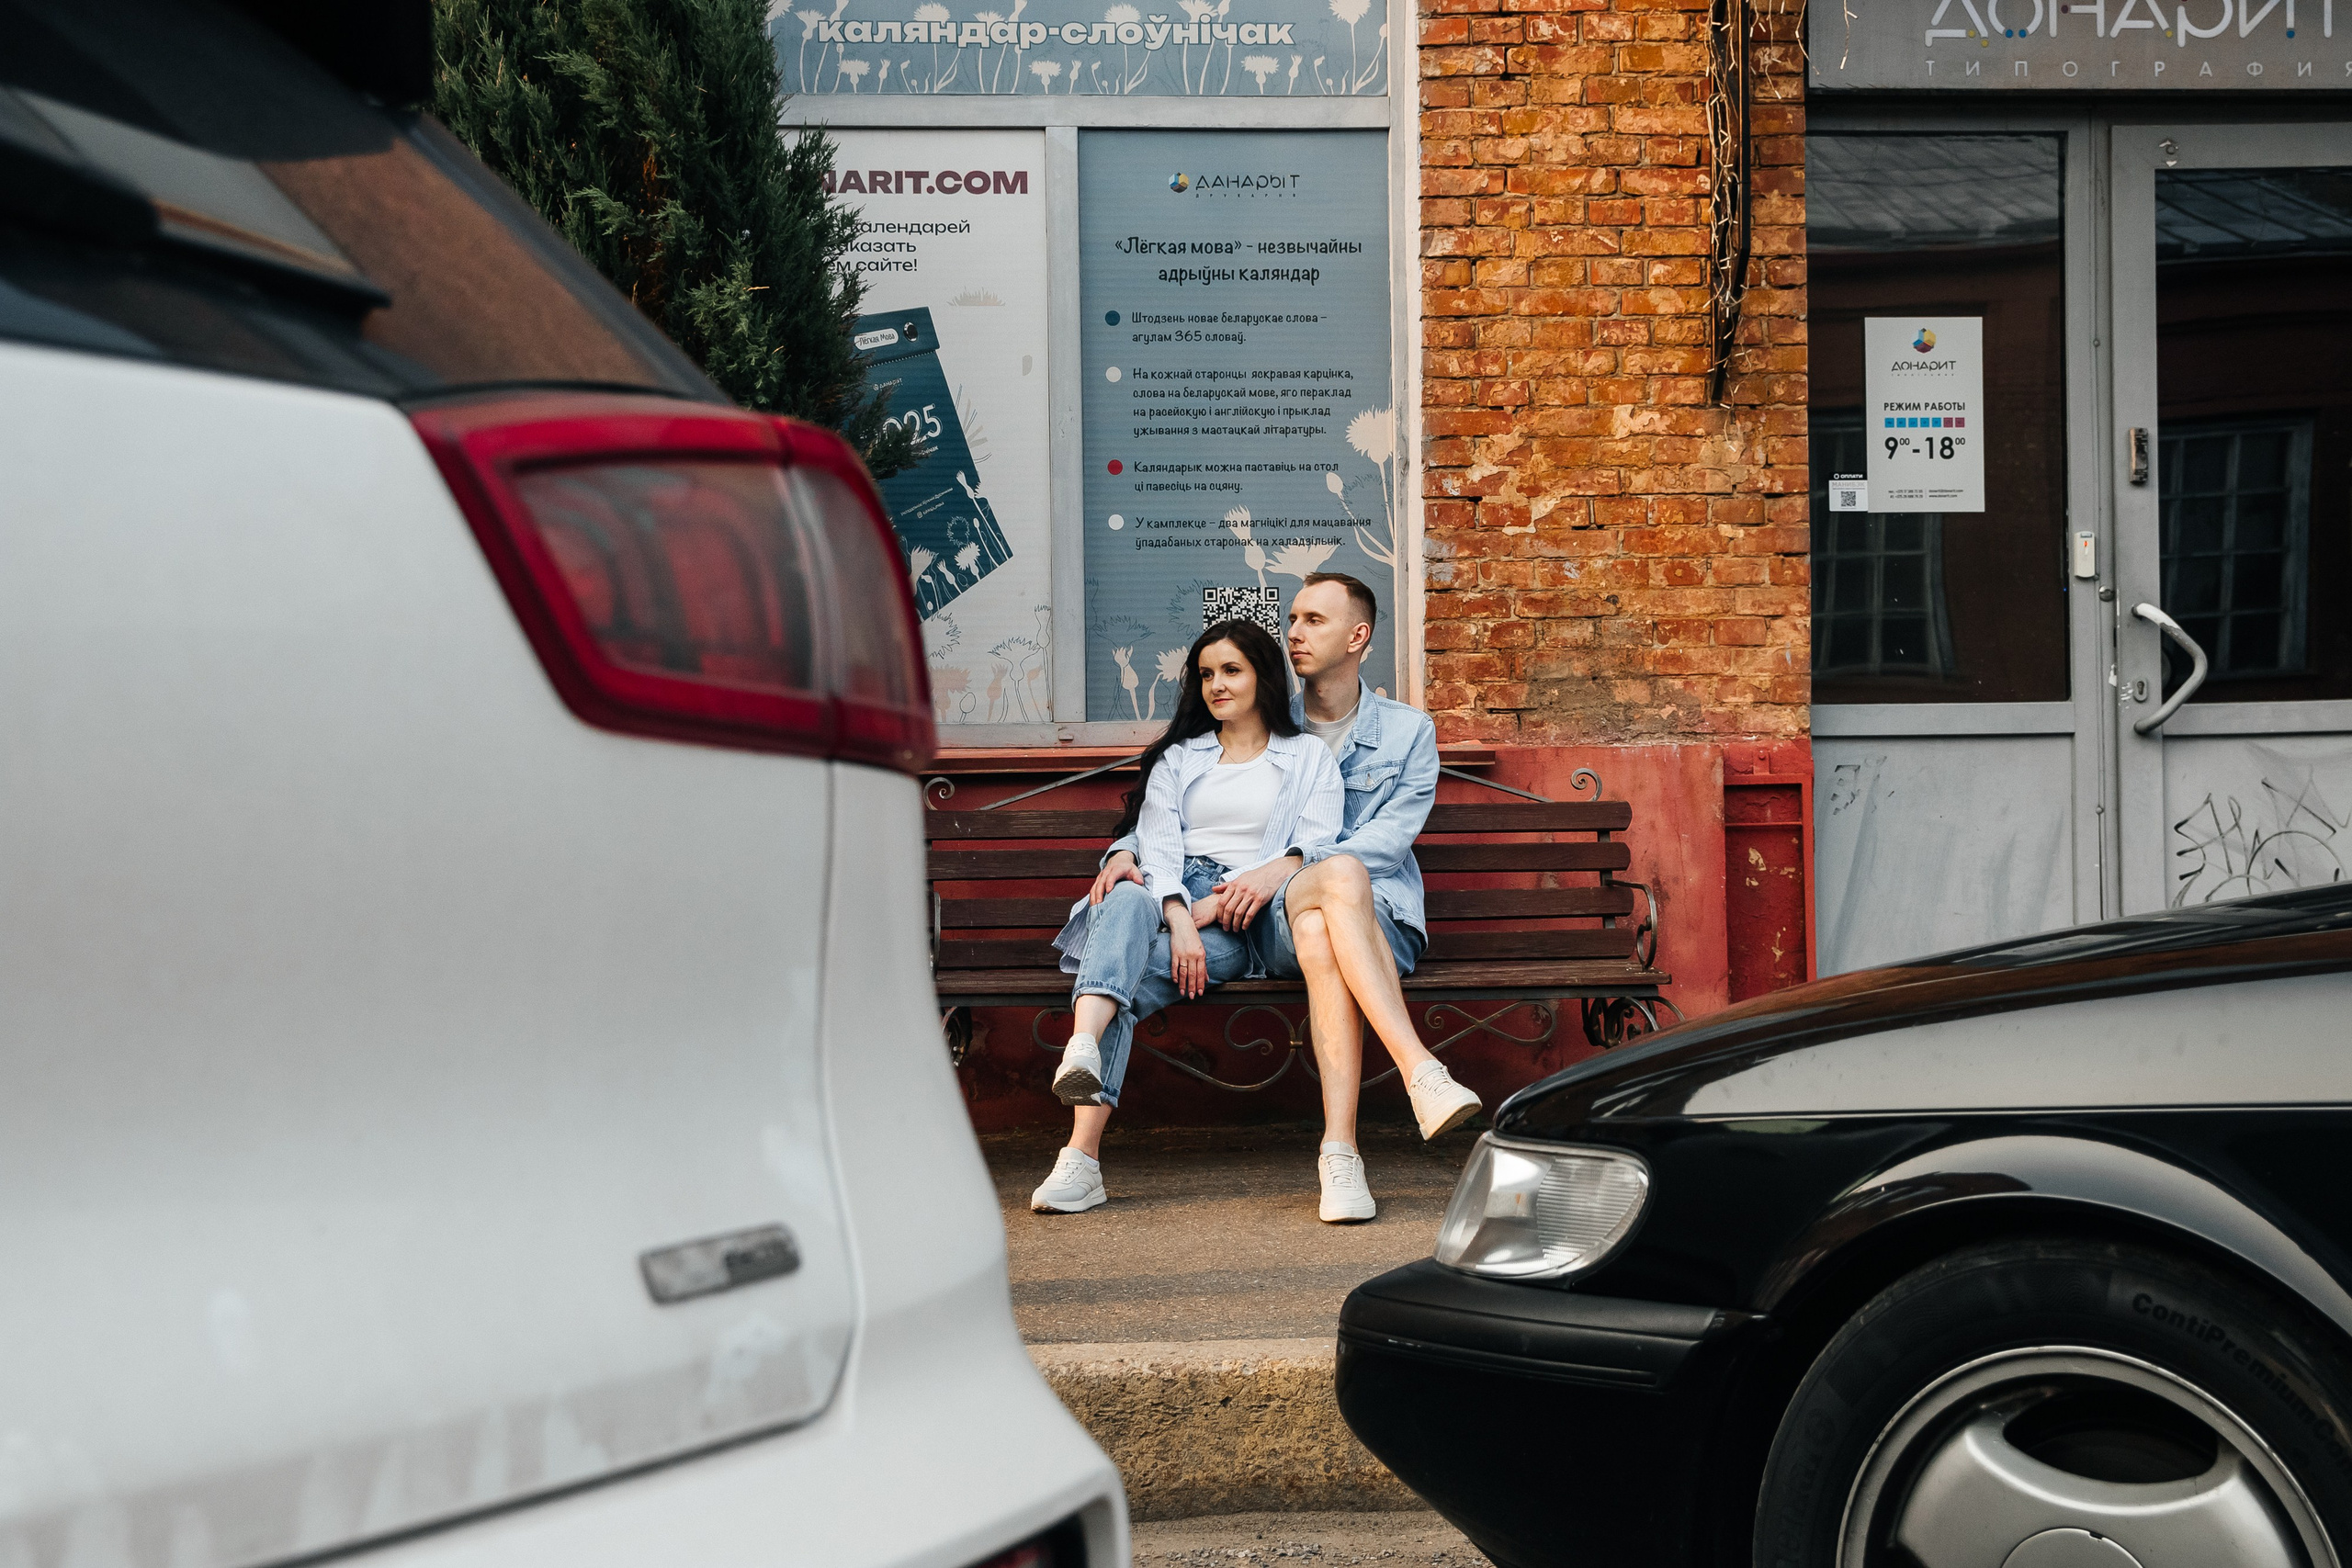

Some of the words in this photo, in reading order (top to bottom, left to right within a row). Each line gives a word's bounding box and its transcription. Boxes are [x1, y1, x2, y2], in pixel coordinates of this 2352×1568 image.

[818, 14, 1296, 50] каляндар-слоўнічак
[1926, 61, 2352, 77] ТИПОГРАФИЯ
[821, 171, 1028, 195] NARIT.COM
[1195, 175, 1300, 190] ДАНАРЫТ
[1115, 236, 1186, 254] «Лёгкая
[1191, 241, 1241, 254] мова»
[1258, 239, 1362, 254] незвычайны
[856, 259, 917, 272] сайте!
[1159, 266, 1234, 287] адрыўны
[1239, 267, 1319, 286] каляндар
[1132, 311, 1185, 324] Штодзень
[1188, 315, 1218, 323] новае
[1221, 312, 1283, 326] беларускае
[1132, 334, 1171, 344] агулам
[1175, 331, 1202, 342] 365
[1205, 332, 1246, 344] словаў.
[1892, 361, 1956, 371] ДОНАРИТ
[1133, 367, 1148, 379] На
[1151, 369, 1193, 379] кожнай
[1195, 370, 1246, 382] старонцы
[1251, 370, 1301, 382] яскравая
[1304, 368, 1353, 382] карцінка,
[1183, 387, 1246, 400] беларускай
[1249, 389, 1278, 399] мове,
[1300, 389, 1351, 400] пераклад
[1149, 407, 1206, 420] расейскую
[1212, 406, 1275, 419] англійскую
[1283, 408, 1330, 419] прыклад
[1884, 402, 1920, 411] РЕЖИМ
[1925, 402, 1965, 411] РАБОТЫ
[1134, 427, 1189, 438] ужывання
[1192, 427, 1198, 435] з
[1202, 424, 1260, 435] мастацкай
[1263, 424, 1326, 438] літаратуры.
[1135, 461, 1203, 476] Каляндарык
[1205, 464, 1242, 472] можна
[1245, 462, 1296, 472] паставіць
[1135, 482, 1143, 491] ці
[1147, 481, 1192, 491] павесіць
[1209, 483, 1243, 493] сцяну.
[1136, 517, 1144, 528] У
[1147, 520, 1206, 529] камплекце
[1218, 518, 1238, 528] два
[1241, 517, 1287, 528] магніцікі
[1291, 519, 1309, 527] для
[1313, 519, 1371, 528] мацавання
[1136, 536, 1202, 550] ўпадабаных
[1204, 537, 1253, 549] старонак
[1272, 536, 1345, 547] халадзільнік.
